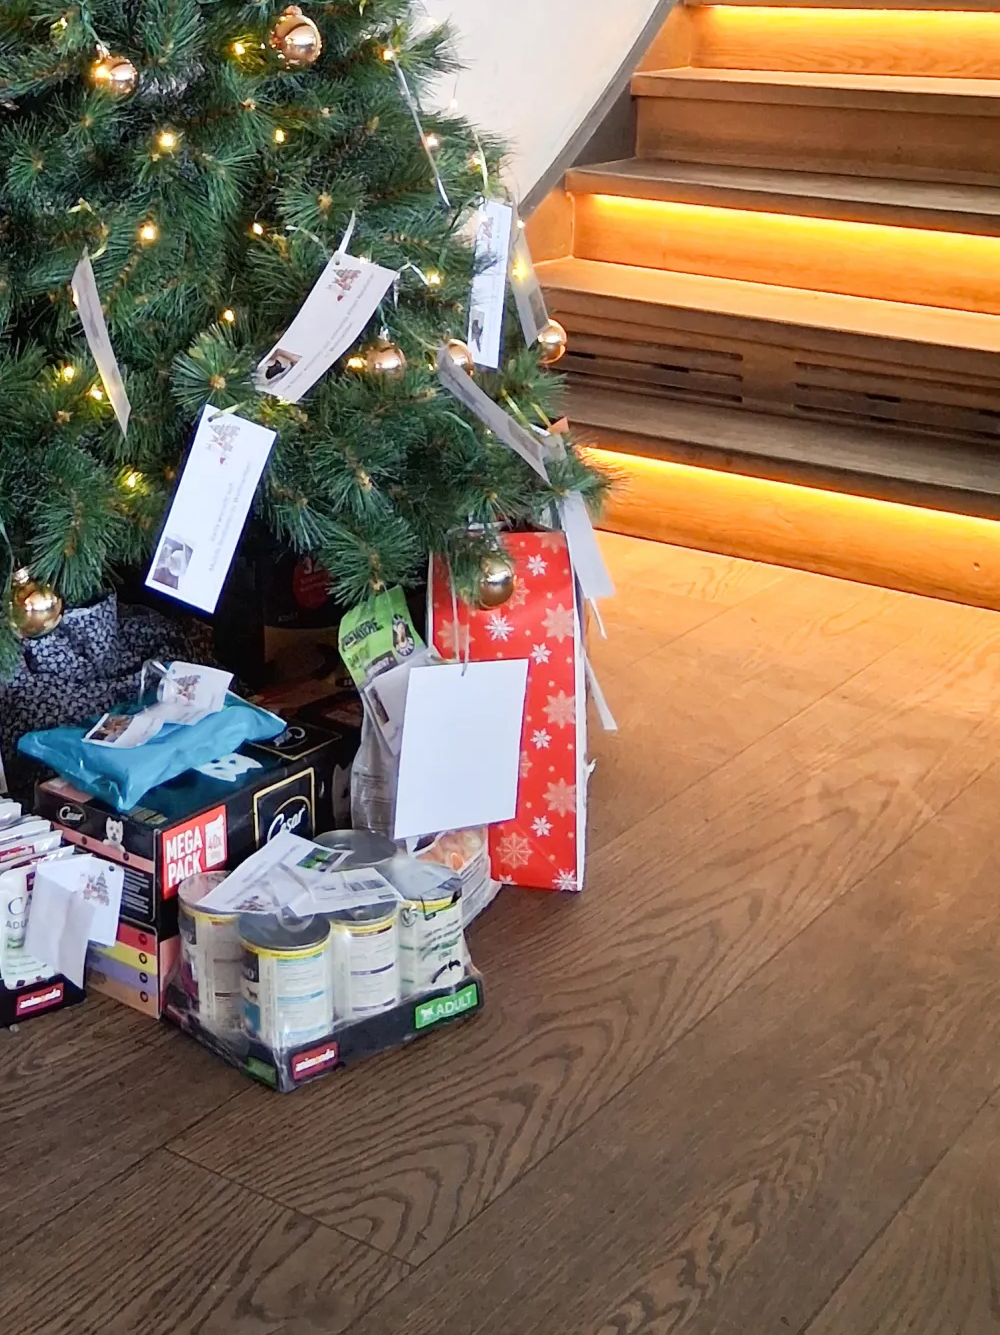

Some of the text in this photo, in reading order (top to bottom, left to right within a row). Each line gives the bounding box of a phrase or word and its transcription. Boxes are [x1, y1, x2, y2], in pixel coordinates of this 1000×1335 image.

[166, 826, 203, 864] MEGA
[168, 849, 202, 888] PACK
[436, 991, 472, 1015] ADULT
